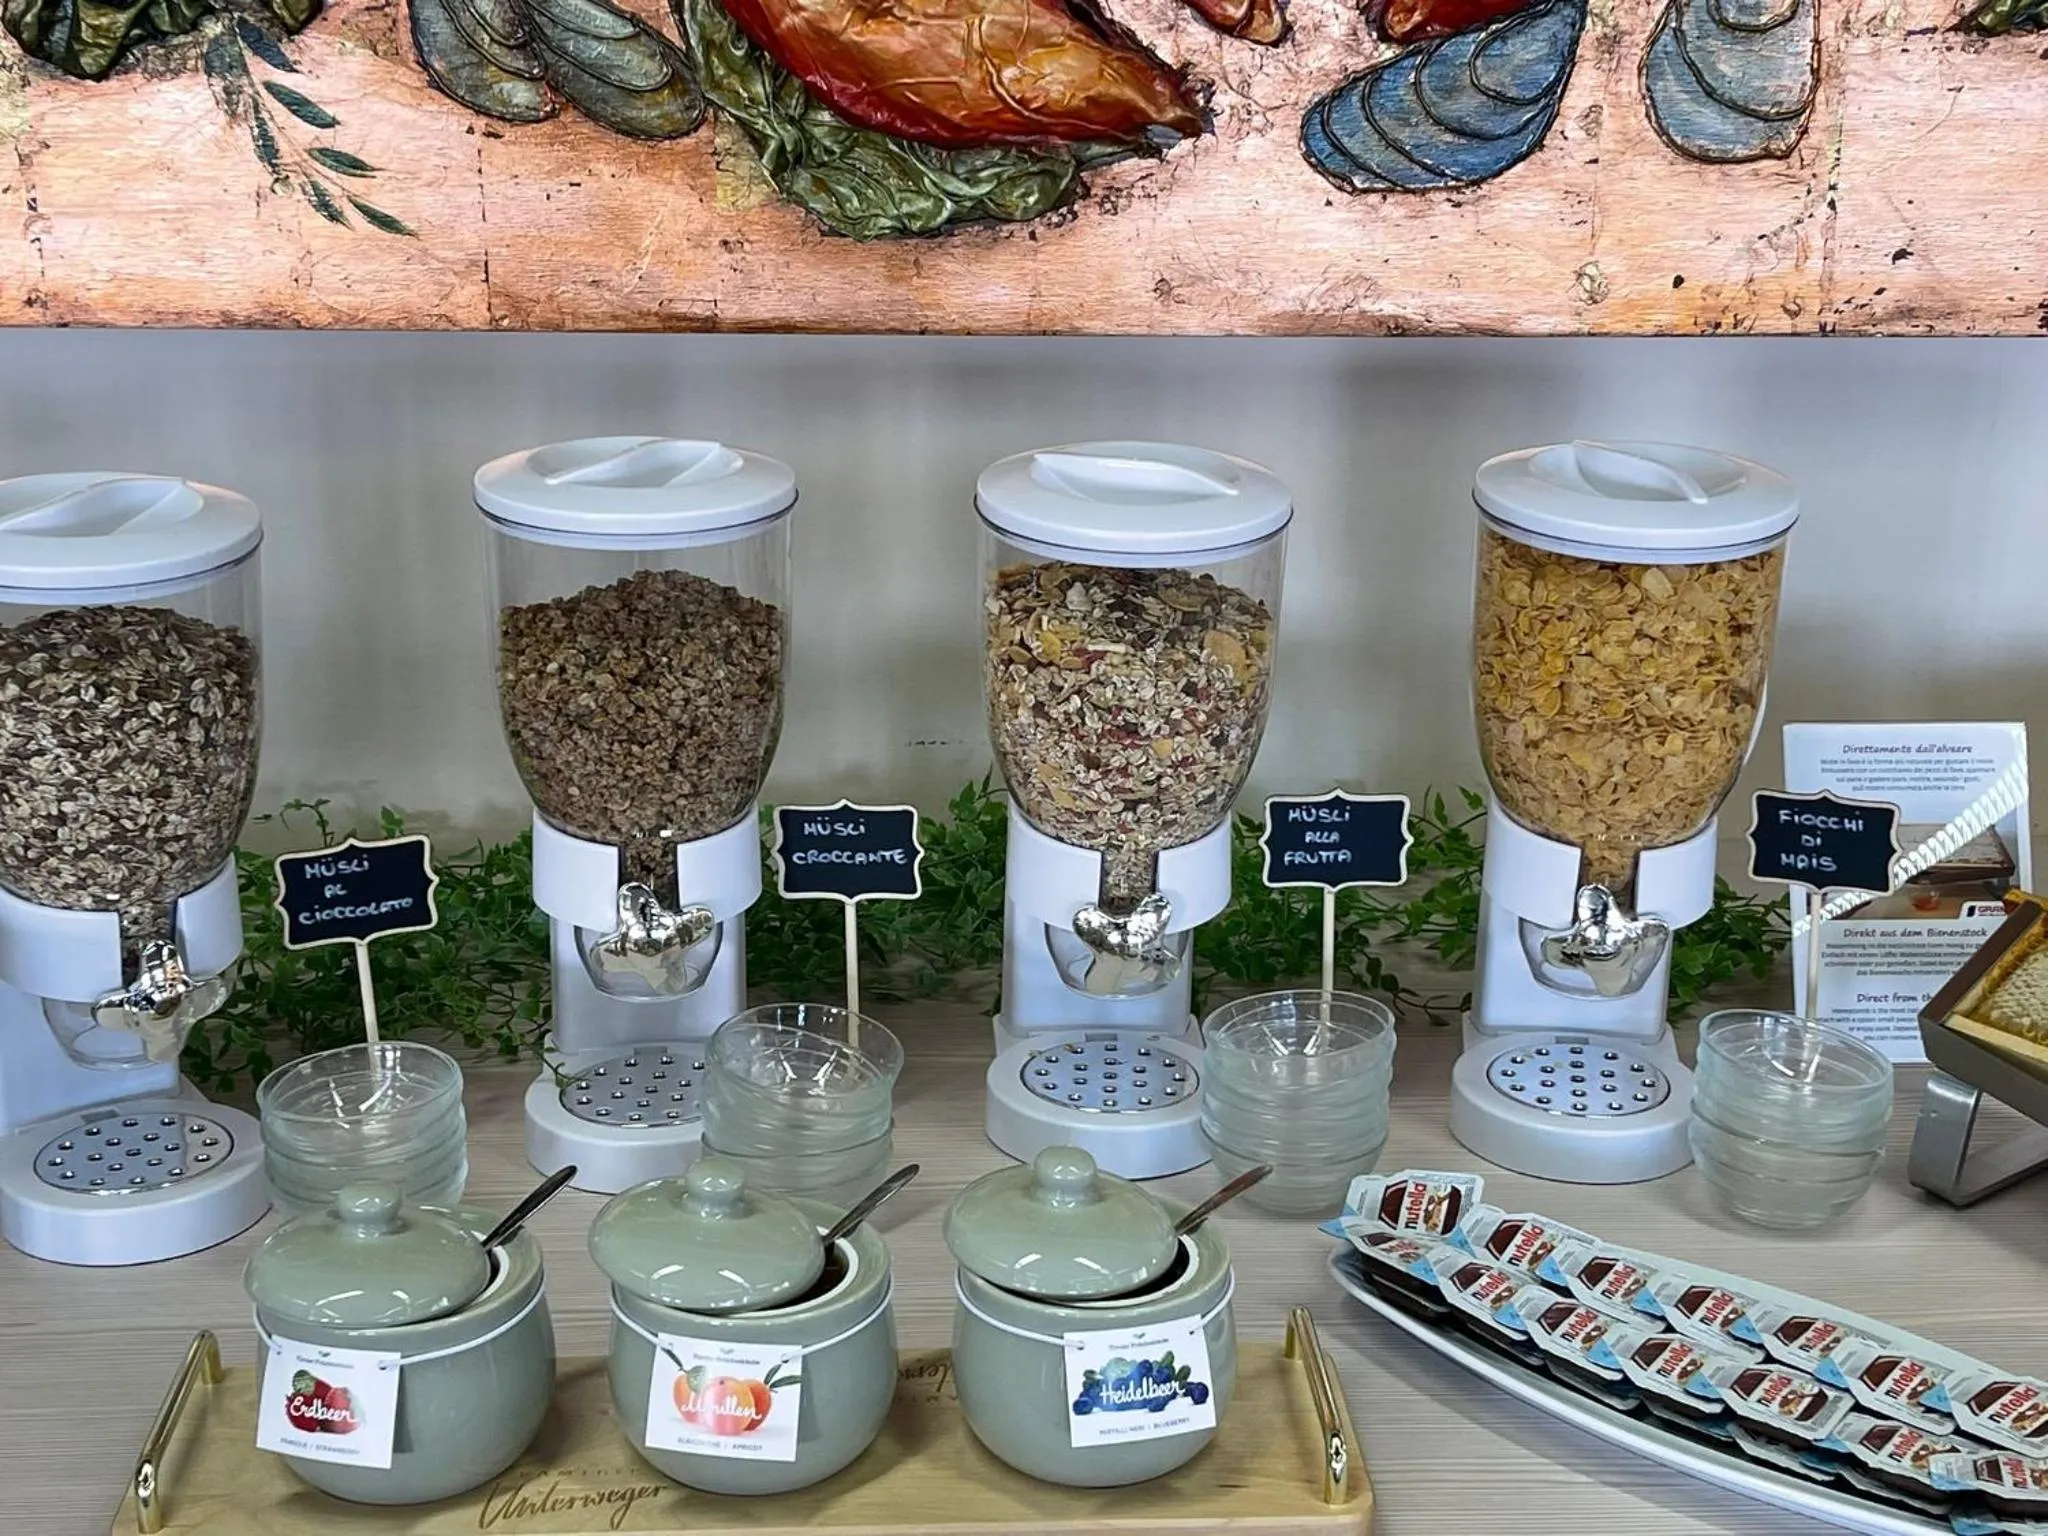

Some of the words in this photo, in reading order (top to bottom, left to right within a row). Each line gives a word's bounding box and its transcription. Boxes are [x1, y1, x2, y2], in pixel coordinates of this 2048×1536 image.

[1304, 831, 1340, 844] ALLA
[792, 848, 907, 865] CROCCANTE
[1283, 849, 1352, 867] FRUTTA
[1843, 927, 1876, 938] Direkt
[1880, 929, 1898, 938] aus
[1900, 927, 1923, 938] dem
[1927, 927, 1988, 938] Bienenstock
[1856, 992, 1889, 1003] Direct
[1892, 992, 1918, 1004] from
[1404, 1182, 1427, 1230] nutella
[1507, 1223, 1544, 1267] nutella
[1471, 1270, 1511, 1301] nutella
[1601, 1264, 1637, 1300] nutella
[1560, 1305, 1599, 1342] nutella
[1699, 1292, 1735, 1326] nutella
[1799, 1322, 1837, 1353] nutella
[1656, 1343, 1694, 1378] nutella
[1759, 1374, 1793, 1407] nutella
[1885, 1361, 1925, 1400] nutella
[290, 1396, 360, 1423] Erdbeer
[1988, 1384, 2040, 1424] nutella
[478, 1479, 668, 1530] Unterweger
